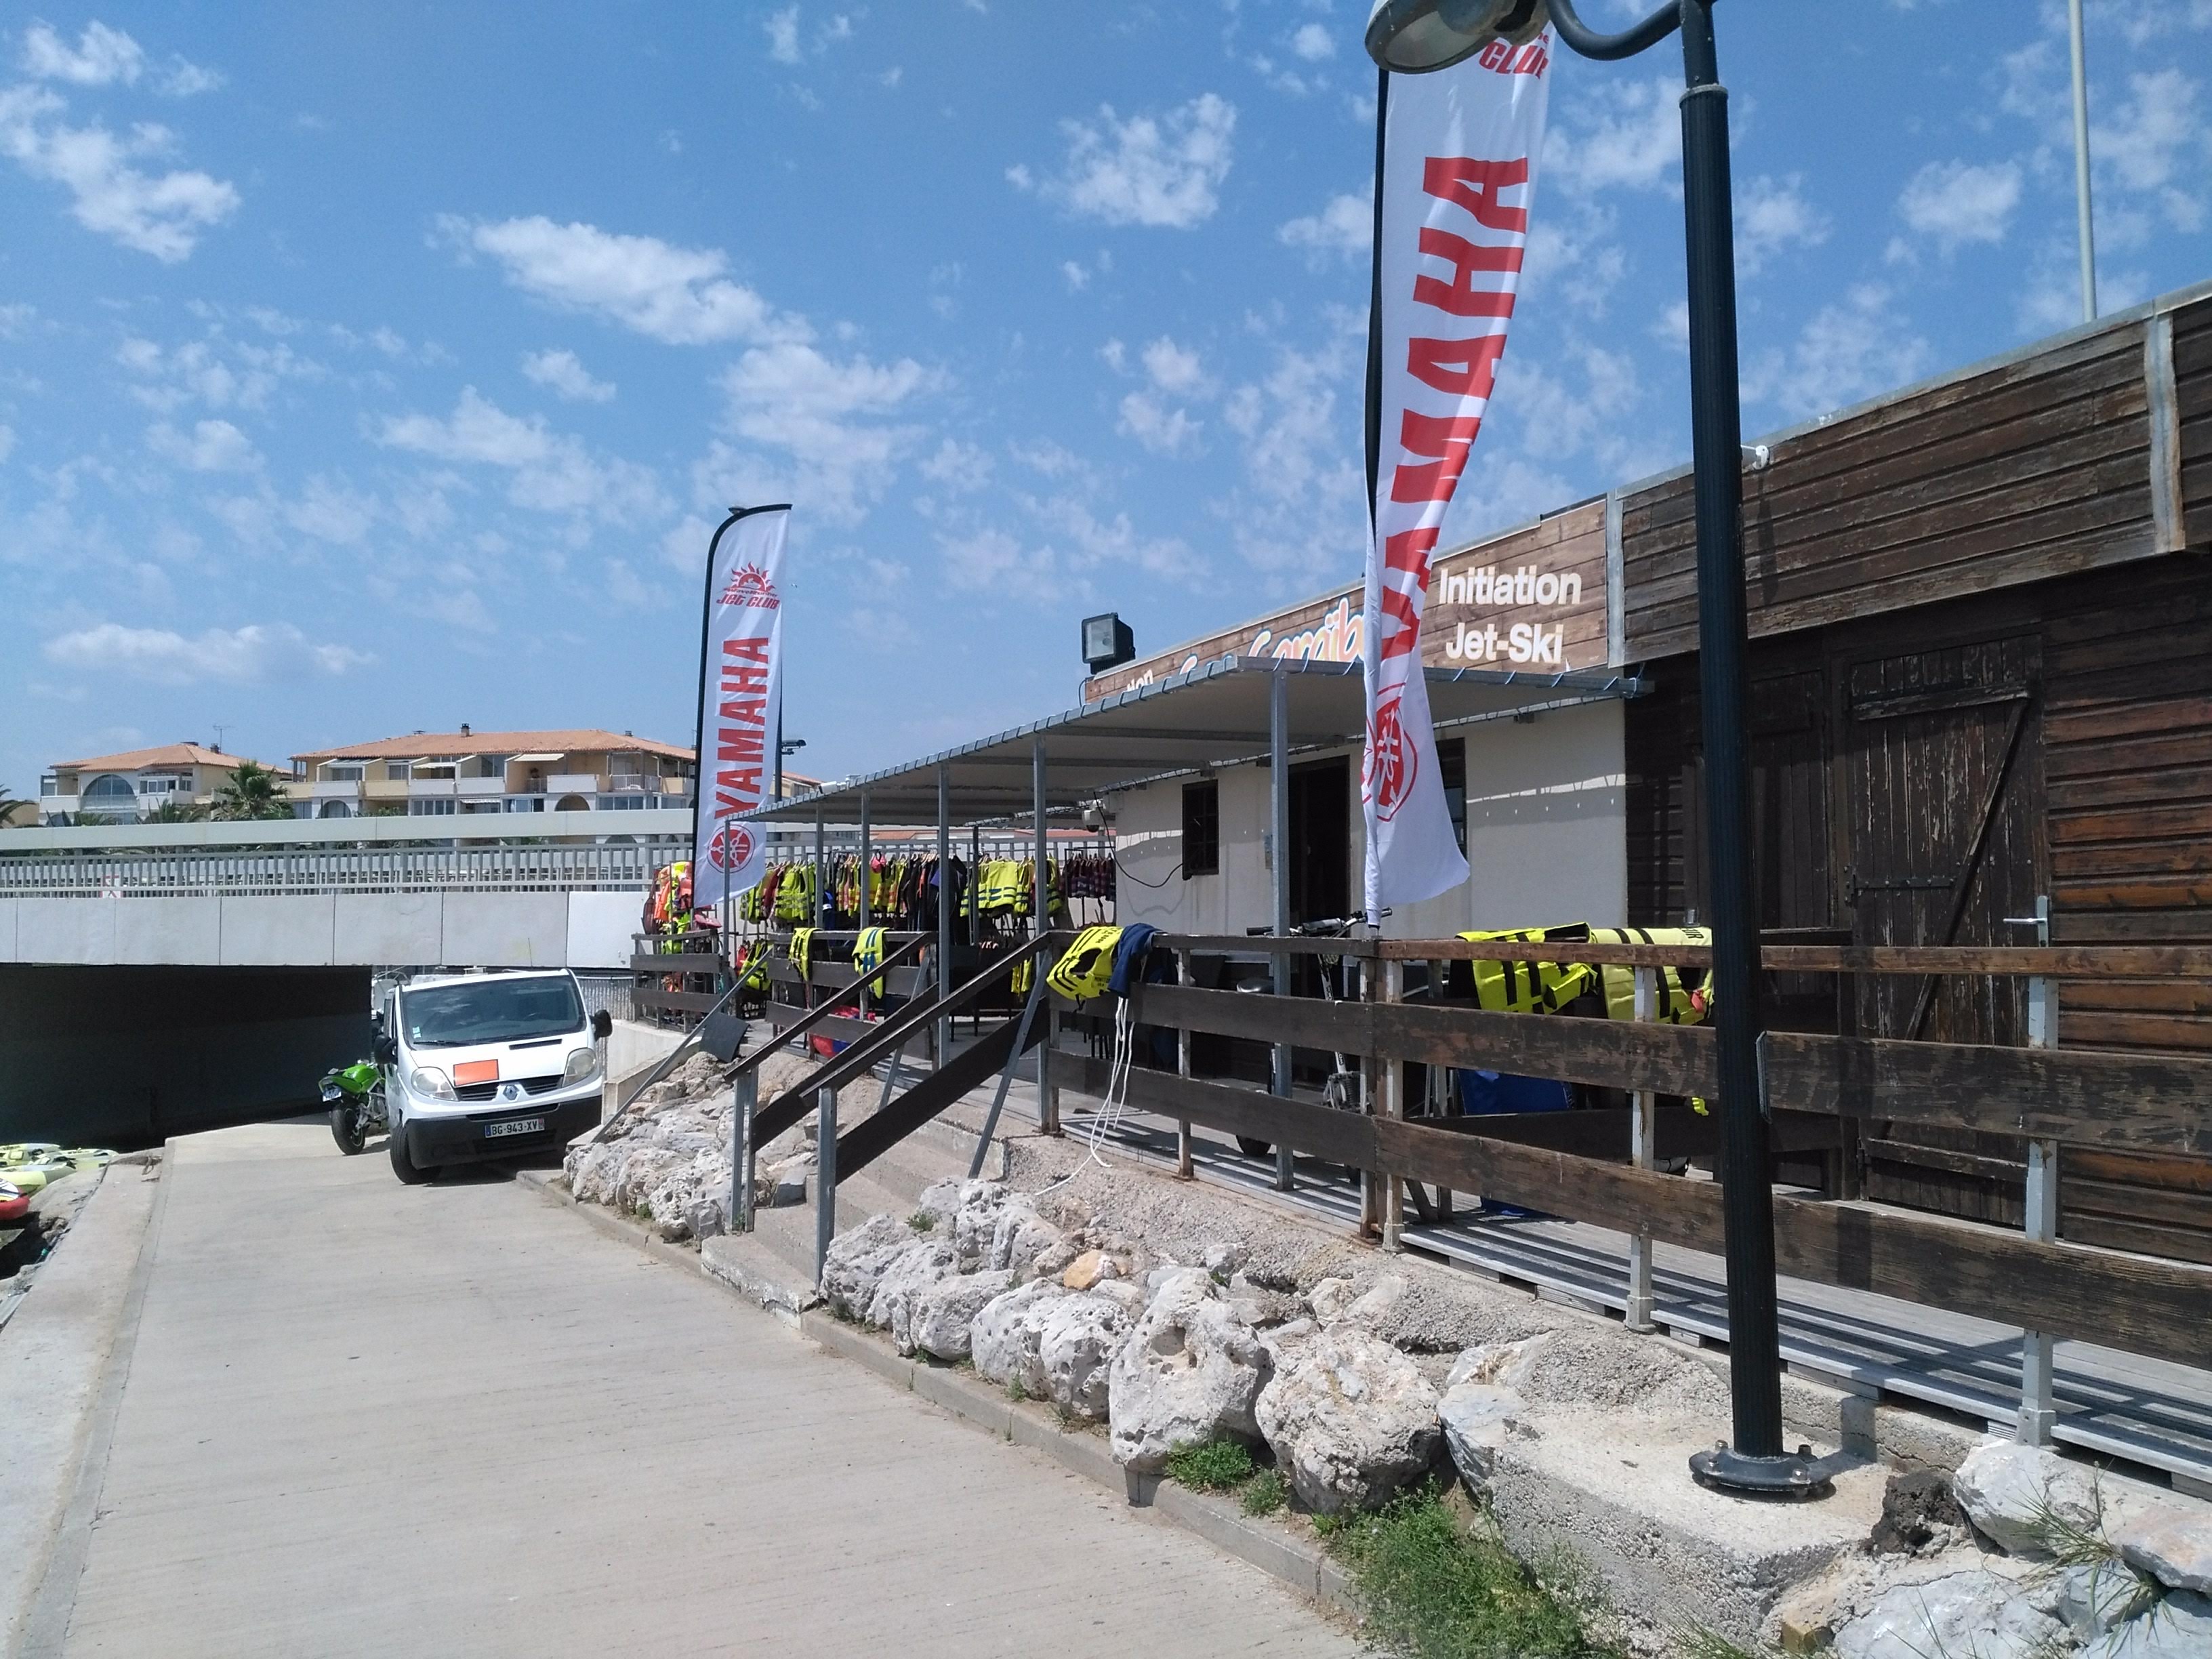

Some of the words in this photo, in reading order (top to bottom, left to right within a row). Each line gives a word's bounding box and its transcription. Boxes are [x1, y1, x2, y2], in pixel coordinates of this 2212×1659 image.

[1380, 157, 1529, 662] YAMAHA
[746, 596, 780, 609] CLUB
[1439, 565, 1582, 605] Initiation
[1446, 622, 1564, 663] Jet-Ski
[714, 637, 769, 819] YAMAHA
[491, 1120, 538, 1136] BG-943-XV
